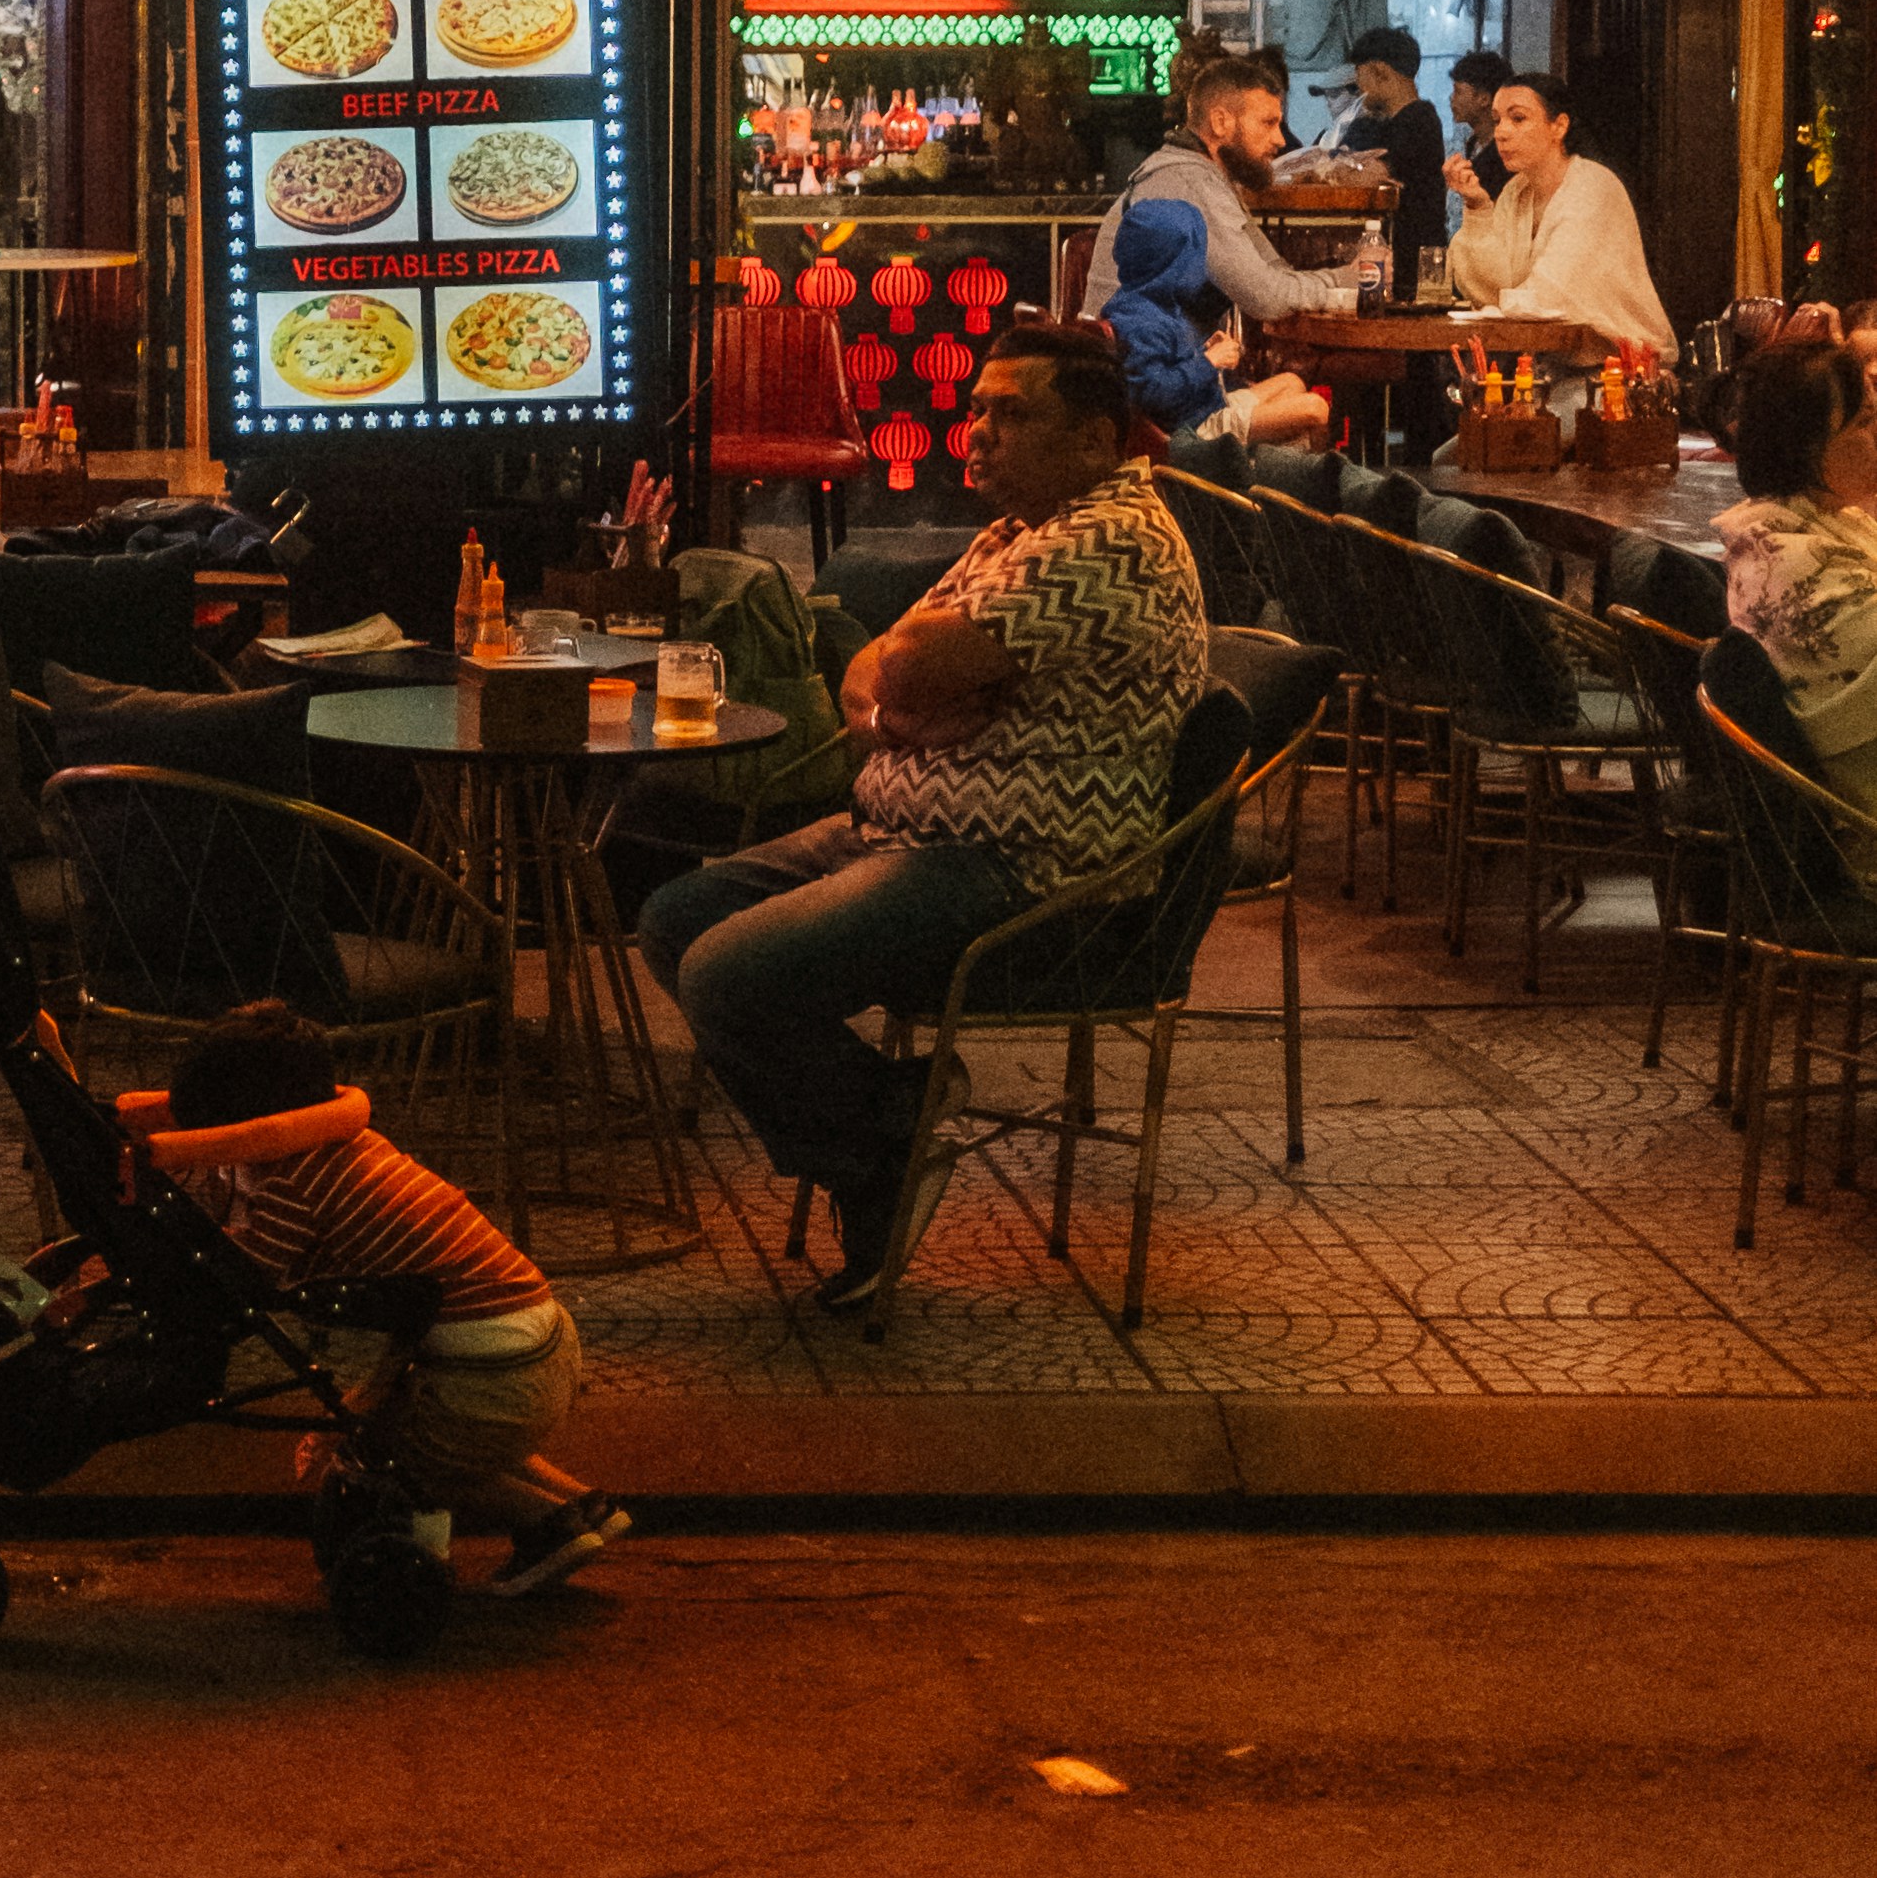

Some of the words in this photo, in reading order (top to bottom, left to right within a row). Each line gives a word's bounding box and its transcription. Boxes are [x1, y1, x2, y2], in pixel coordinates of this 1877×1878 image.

[342, 94, 408, 118] BEEF
[417, 89, 500, 114] PIZZA
[292, 252, 469, 282] VEGETABLES
[477, 249, 561, 275] PIZZA
